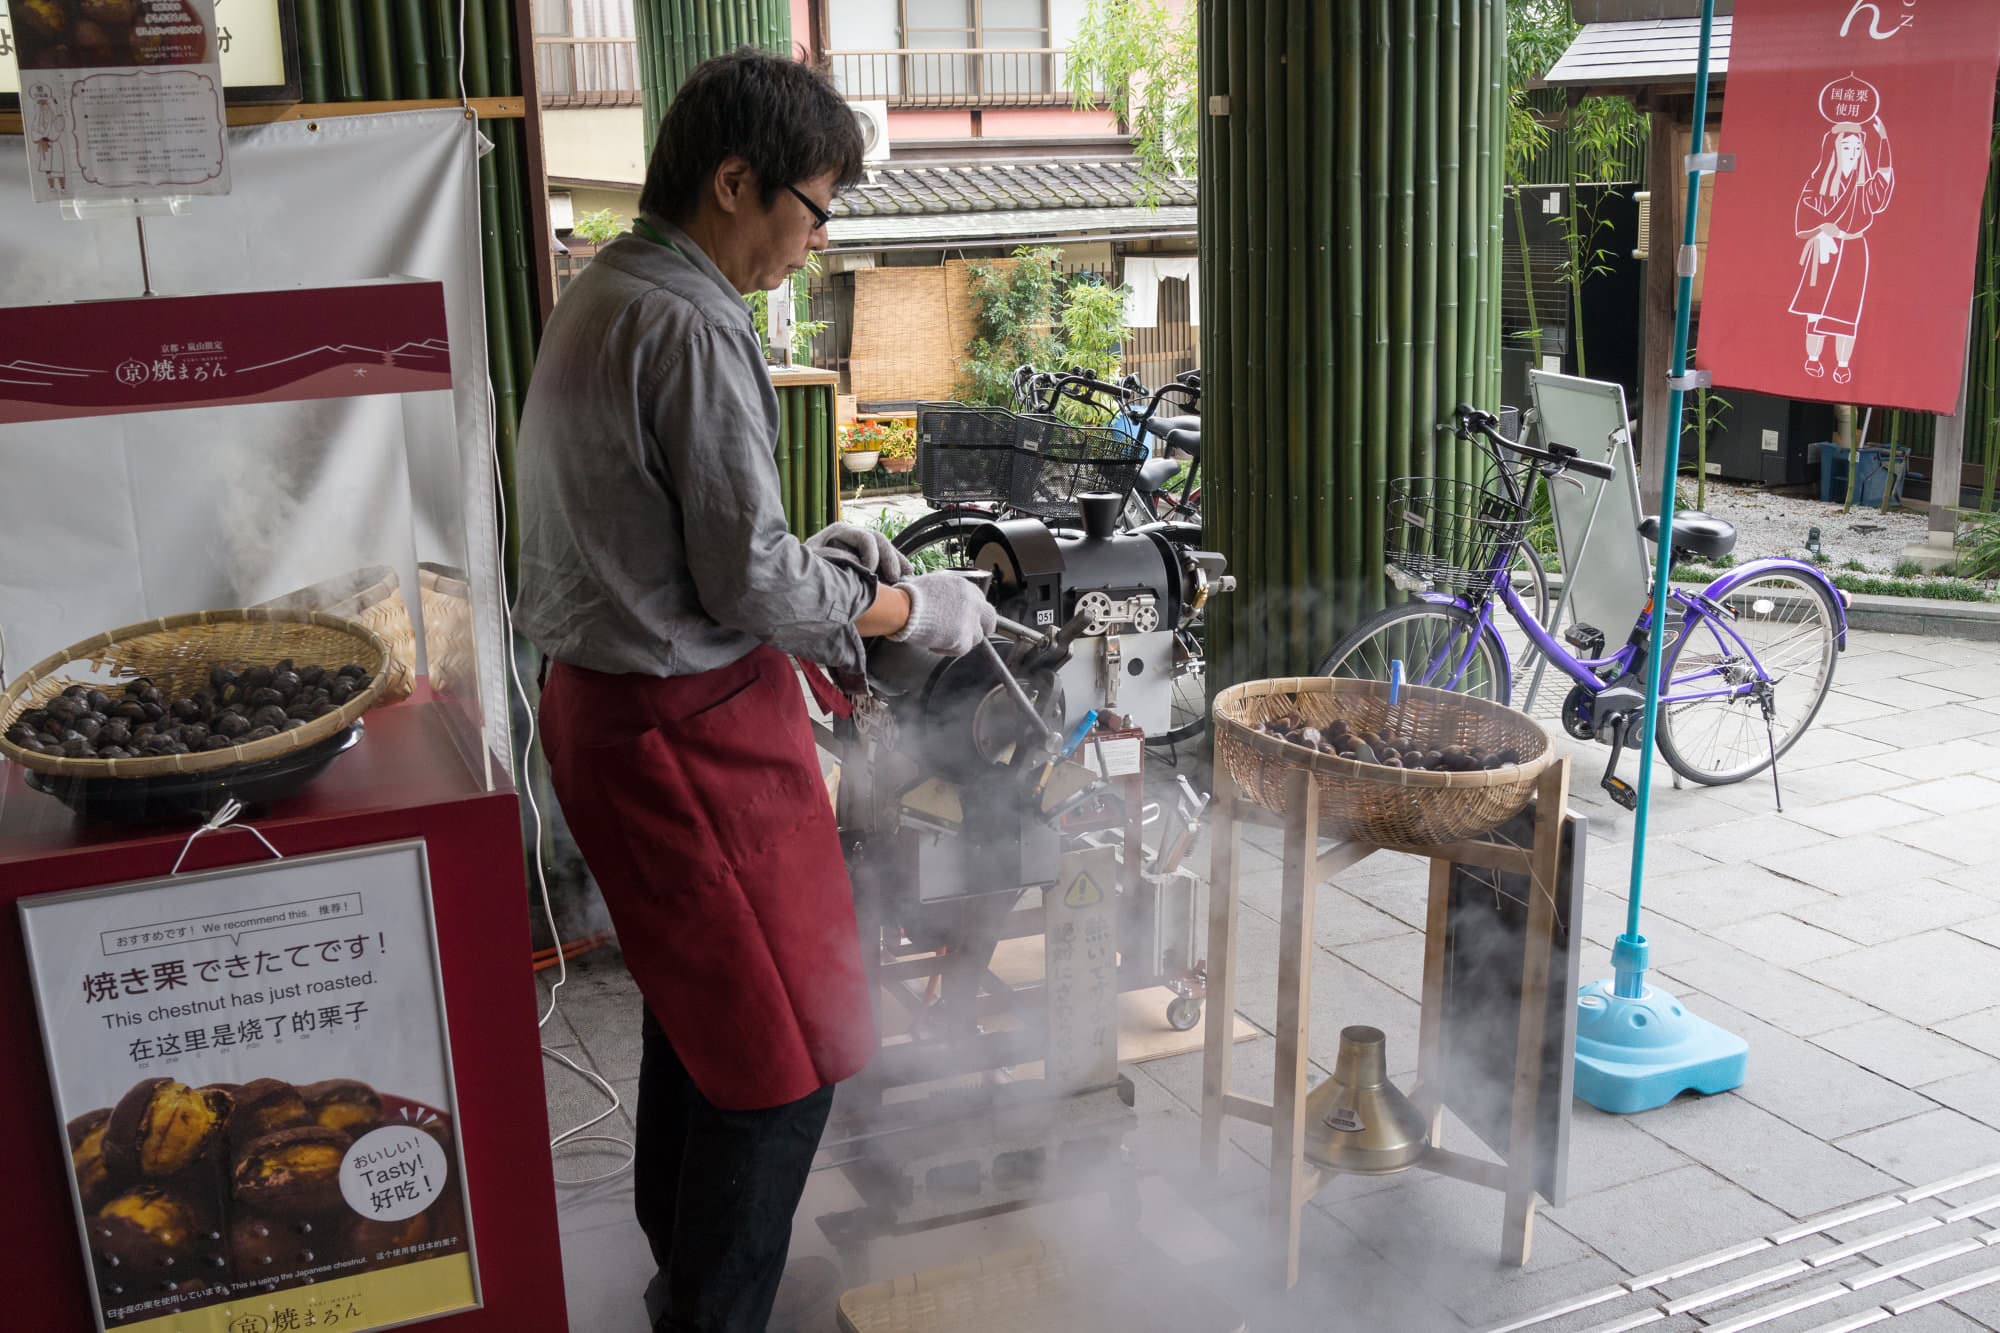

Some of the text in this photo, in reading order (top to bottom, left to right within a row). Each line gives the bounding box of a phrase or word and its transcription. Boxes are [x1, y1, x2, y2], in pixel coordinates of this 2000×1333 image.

[1831, 87, 1869, 102] 国産栗
[1836, 103, 1860, 118] 使用
[202, 923, 221, 933] We
[223, 912, 286, 930] recommend
[288, 908, 310, 920] this.
[102, 970, 378, 1030] This chestnut has just roasted.
[129, 1001, 369, 1063] 在这里是烧了的栗子
[360, 1153, 425, 1188] Tasty!
[370, 1175, 434, 1213] 好吃！
[231, 1282, 249, 1291] This
[258, 1275, 280, 1286] using
[281, 1272, 294, 1281] the
[295, 1264, 332, 1278] Japanese
[333, 1256, 368, 1269] chestnut.
